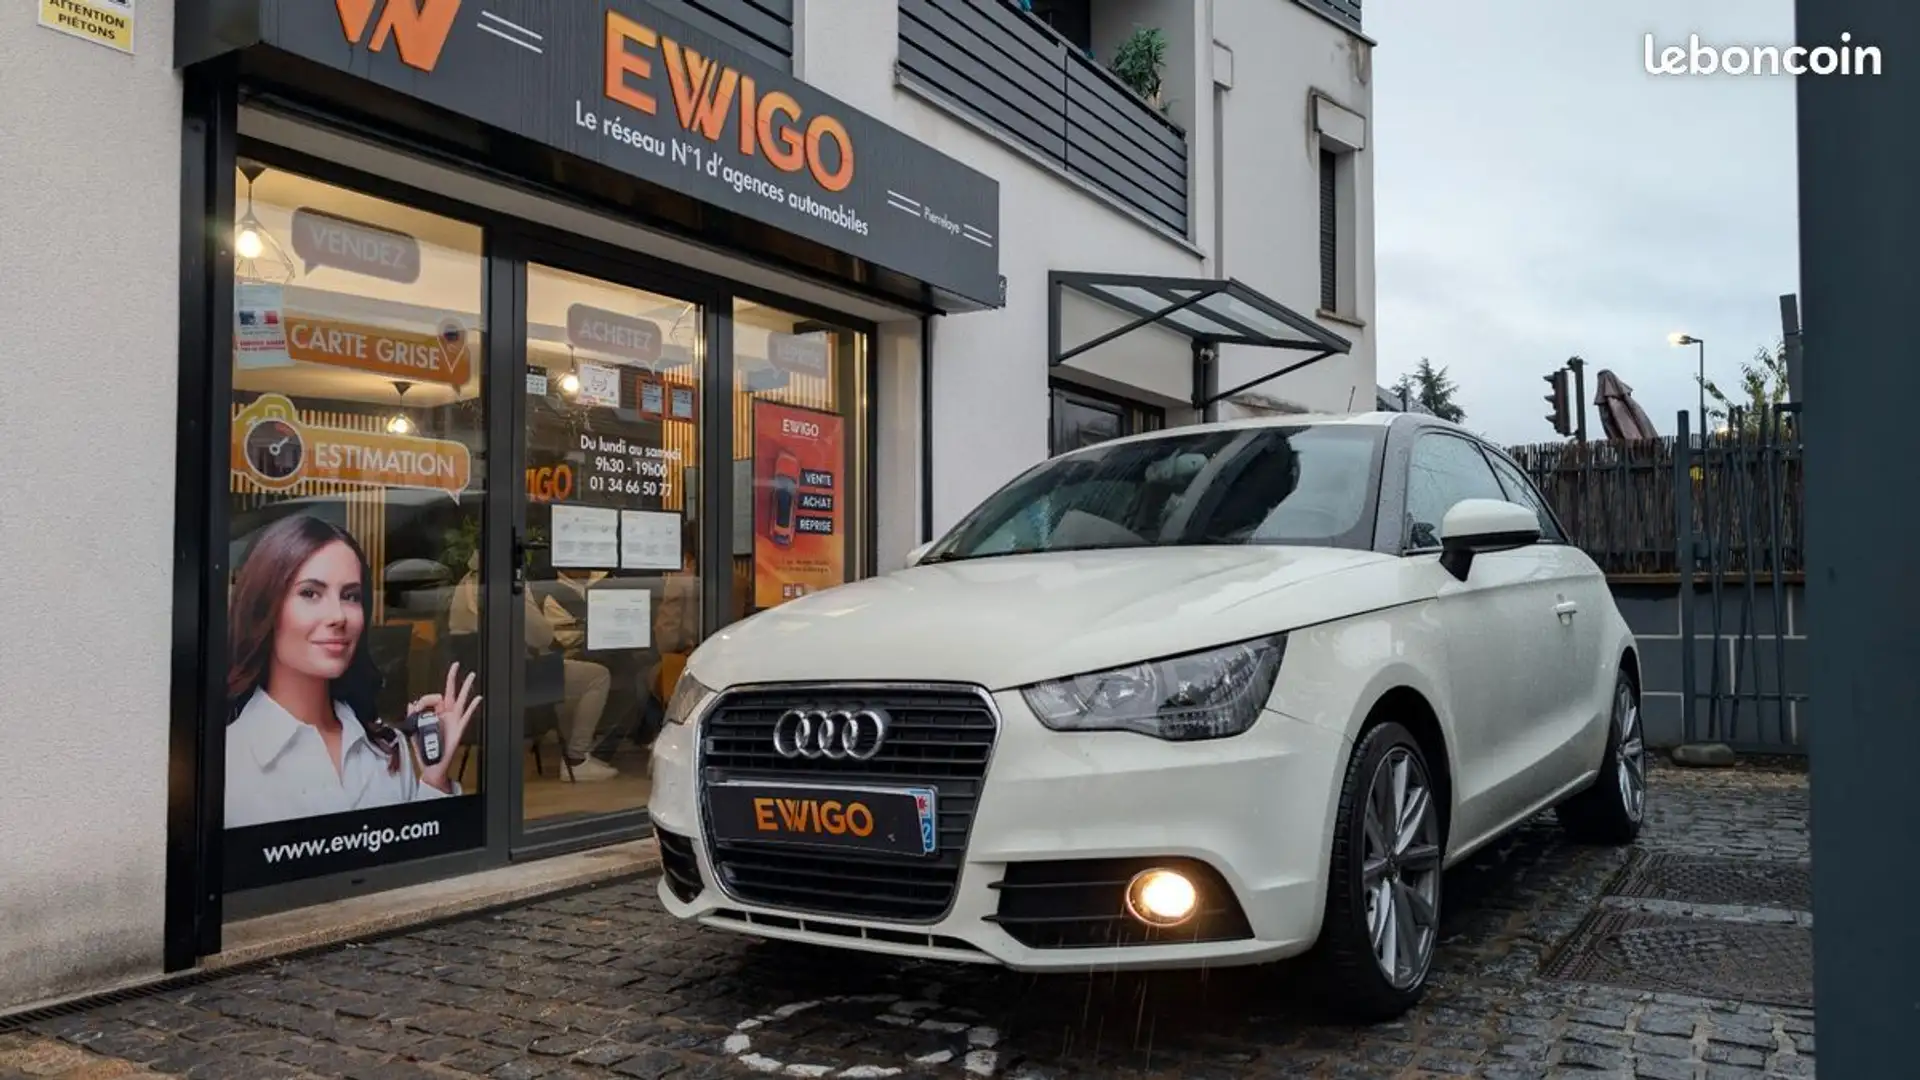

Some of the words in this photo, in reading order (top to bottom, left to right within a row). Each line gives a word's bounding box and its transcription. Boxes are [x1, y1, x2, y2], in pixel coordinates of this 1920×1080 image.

[50, 0, 124, 28] ATTENTION
[58, 14, 115, 39] PIÉTONS
[606, 9, 854, 192] EWIGO
[576, 100, 596, 130] Le
[604, 117, 665, 156] réseau
[672, 138, 701, 171] N°1
[706, 152, 784, 202] d'agences
[789, 192, 868, 236] automobiles
[924, 205, 960, 235] Pierrelaye
[309, 224, 407, 268] VENDEZ
[291, 324, 367, 359] CARTE
[376, 339, 440, 370] GRISE
[579, 319, 652, 348] ACHETEZ
[782, 419, 819, 437] EWIGO
[315, 442, 455, 478] ESTIMATION
[580, 434, 596, 450] Du
[599, 435, 626, 454] lundi
[628, 445, 642, 457] au
[645, 447, 681, 460] samedi
[595, 456, 624, 473] 9h30
[635, 460, 668, 478] 19h00
[805, 471, 831, 486] VENTE
[526, 465, 572, 501] IGO
[590, 476, 604, 491] 01
[608, 478, 622, 492] 34
[625, 480, 640, 494] 66
[643, 481, 657, 496] 50
[659, 483, 672, 497] 77
[803, 496, 831, 509] ACHAT
[800, 518, 831, 532] REPRISE
[753, 798, 875, 837] EWIGO
[263, 819, 440, 864] www.ewigo.com
